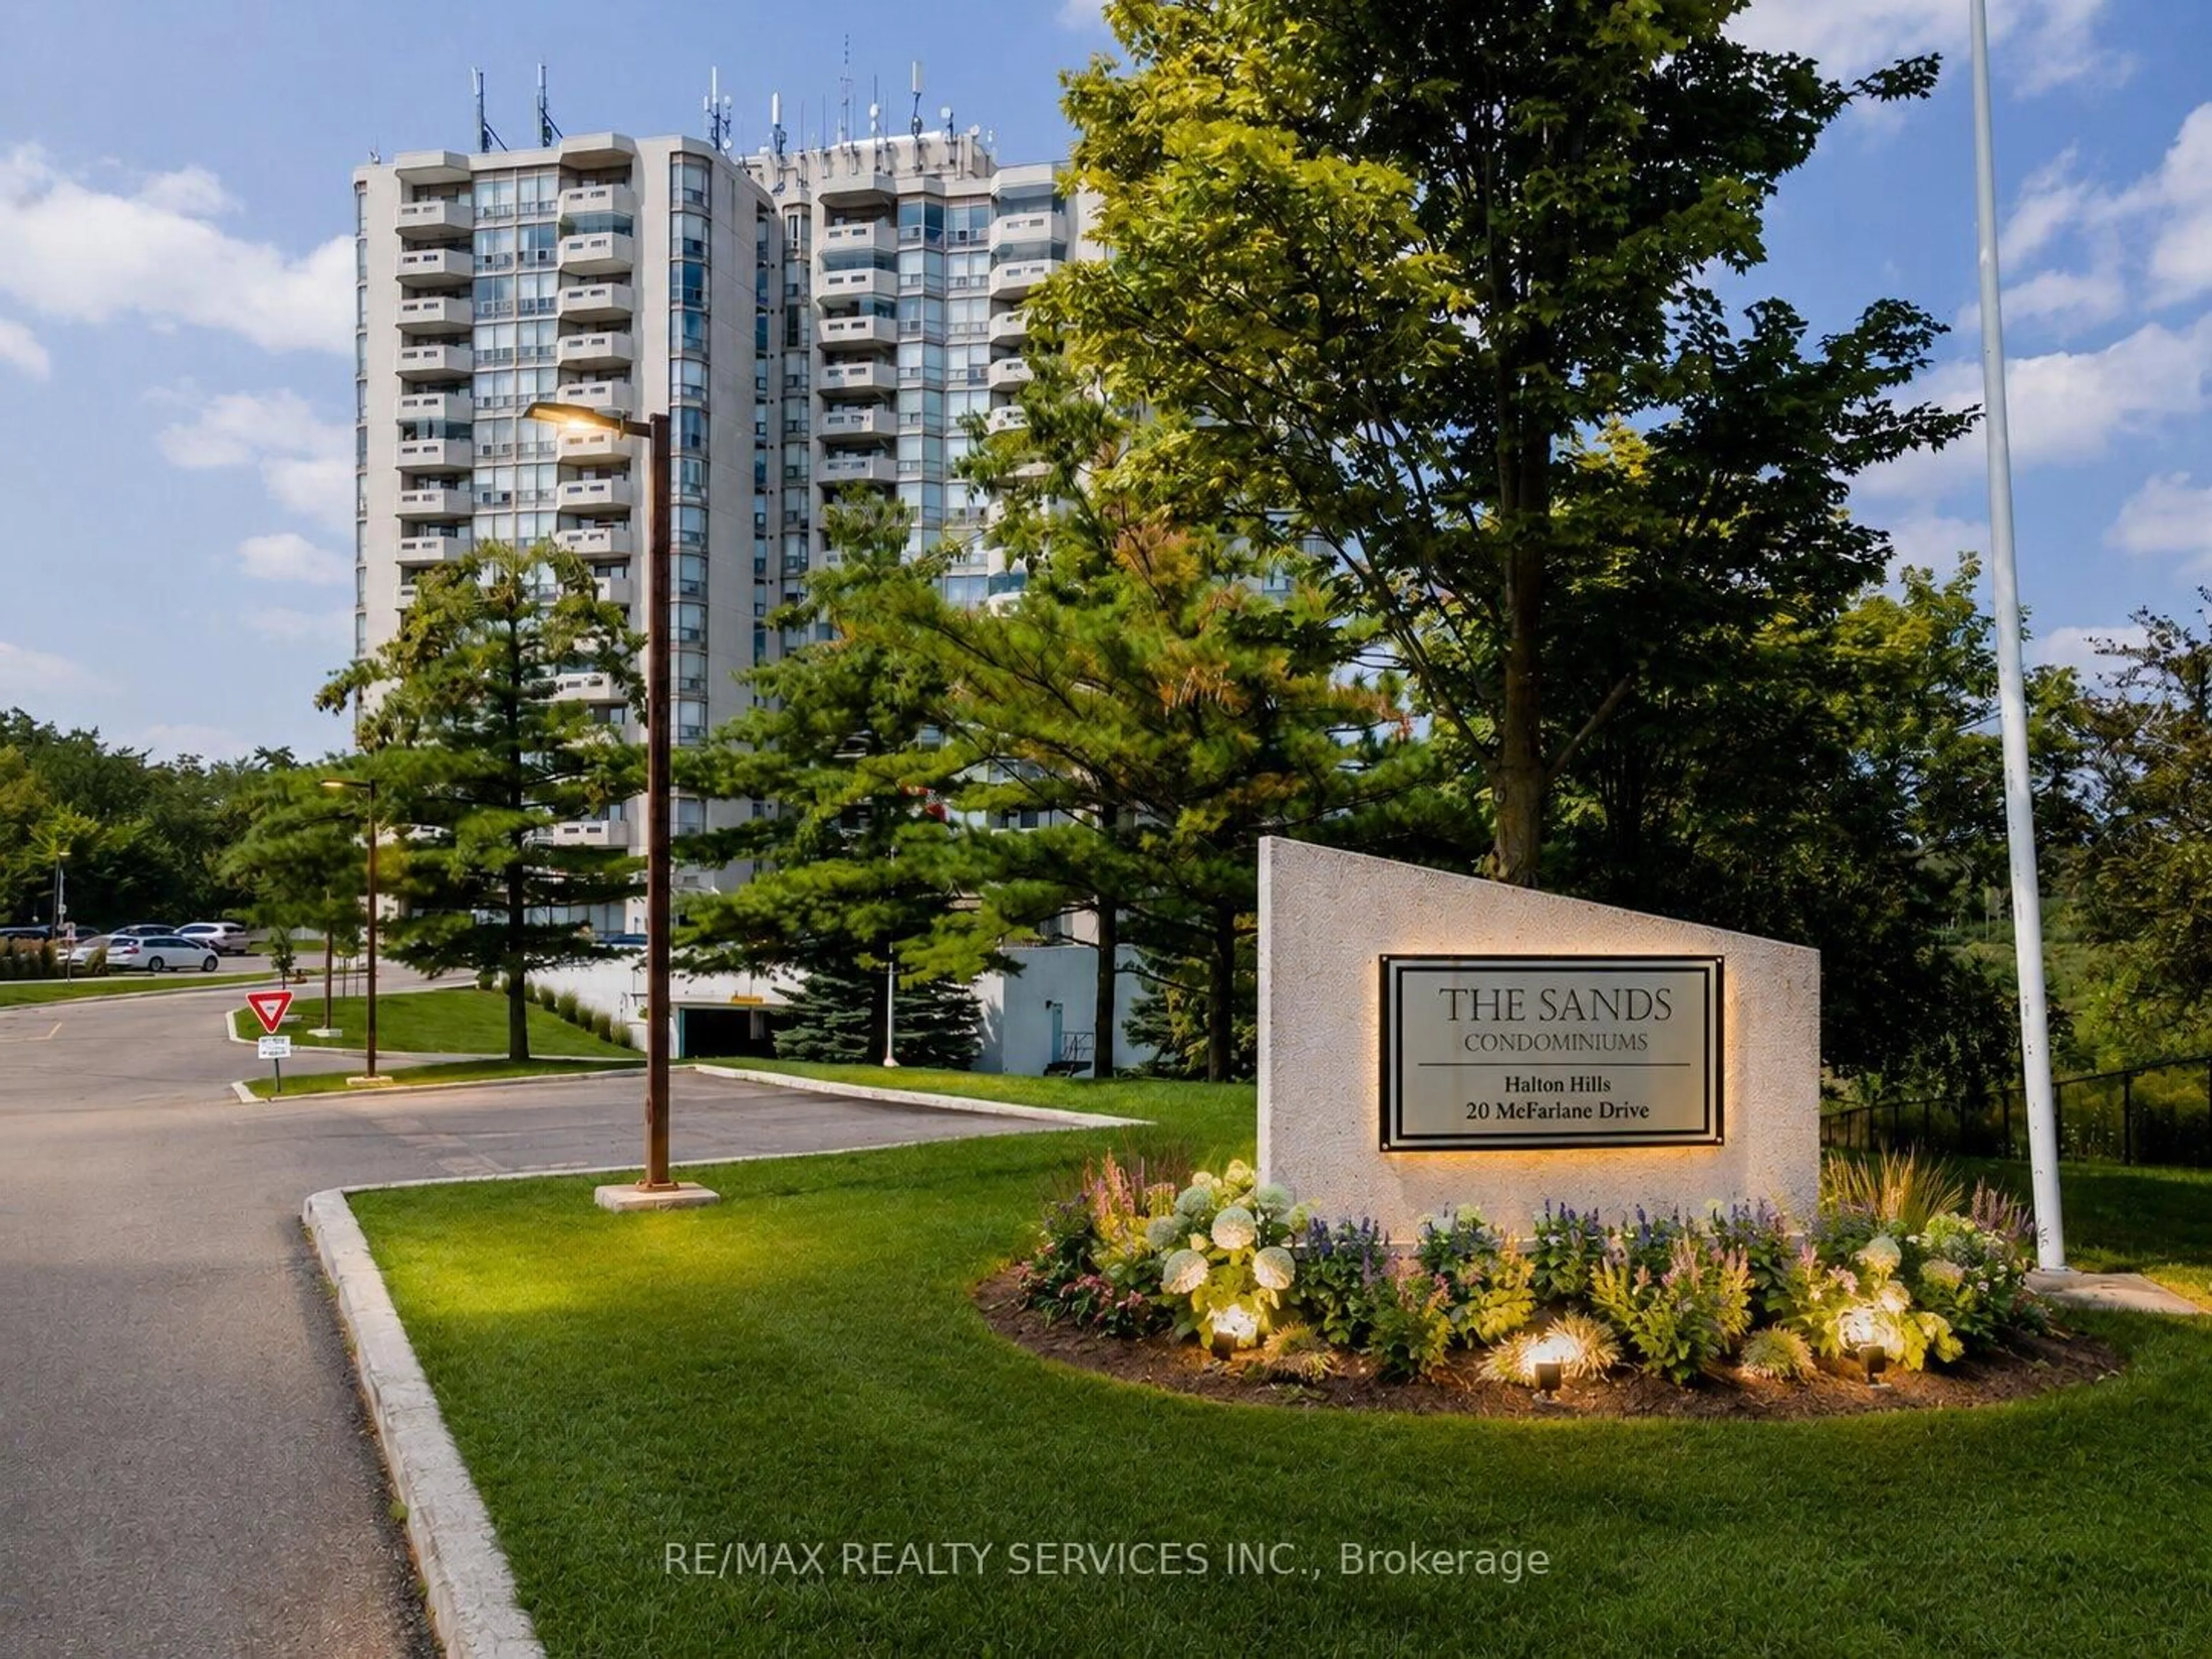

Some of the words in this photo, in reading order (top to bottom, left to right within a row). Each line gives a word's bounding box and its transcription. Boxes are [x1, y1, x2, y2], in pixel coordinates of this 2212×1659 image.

[1439, 988, 1526, 1021] THE
[1539, 988, 1672, 1021] SANDS
[1465, 1033, 1648, 1052] CONDOMINIUMS
[1505, 1076, 1564, 1093] Halton
[1570, 1076, 1612, 1093] Hills
[1466, 1103, 1489, 1120] 20
[1497, 1101, 1593, 1119] McFarlane
[1599, 1101, 1649, 1119] Drive
